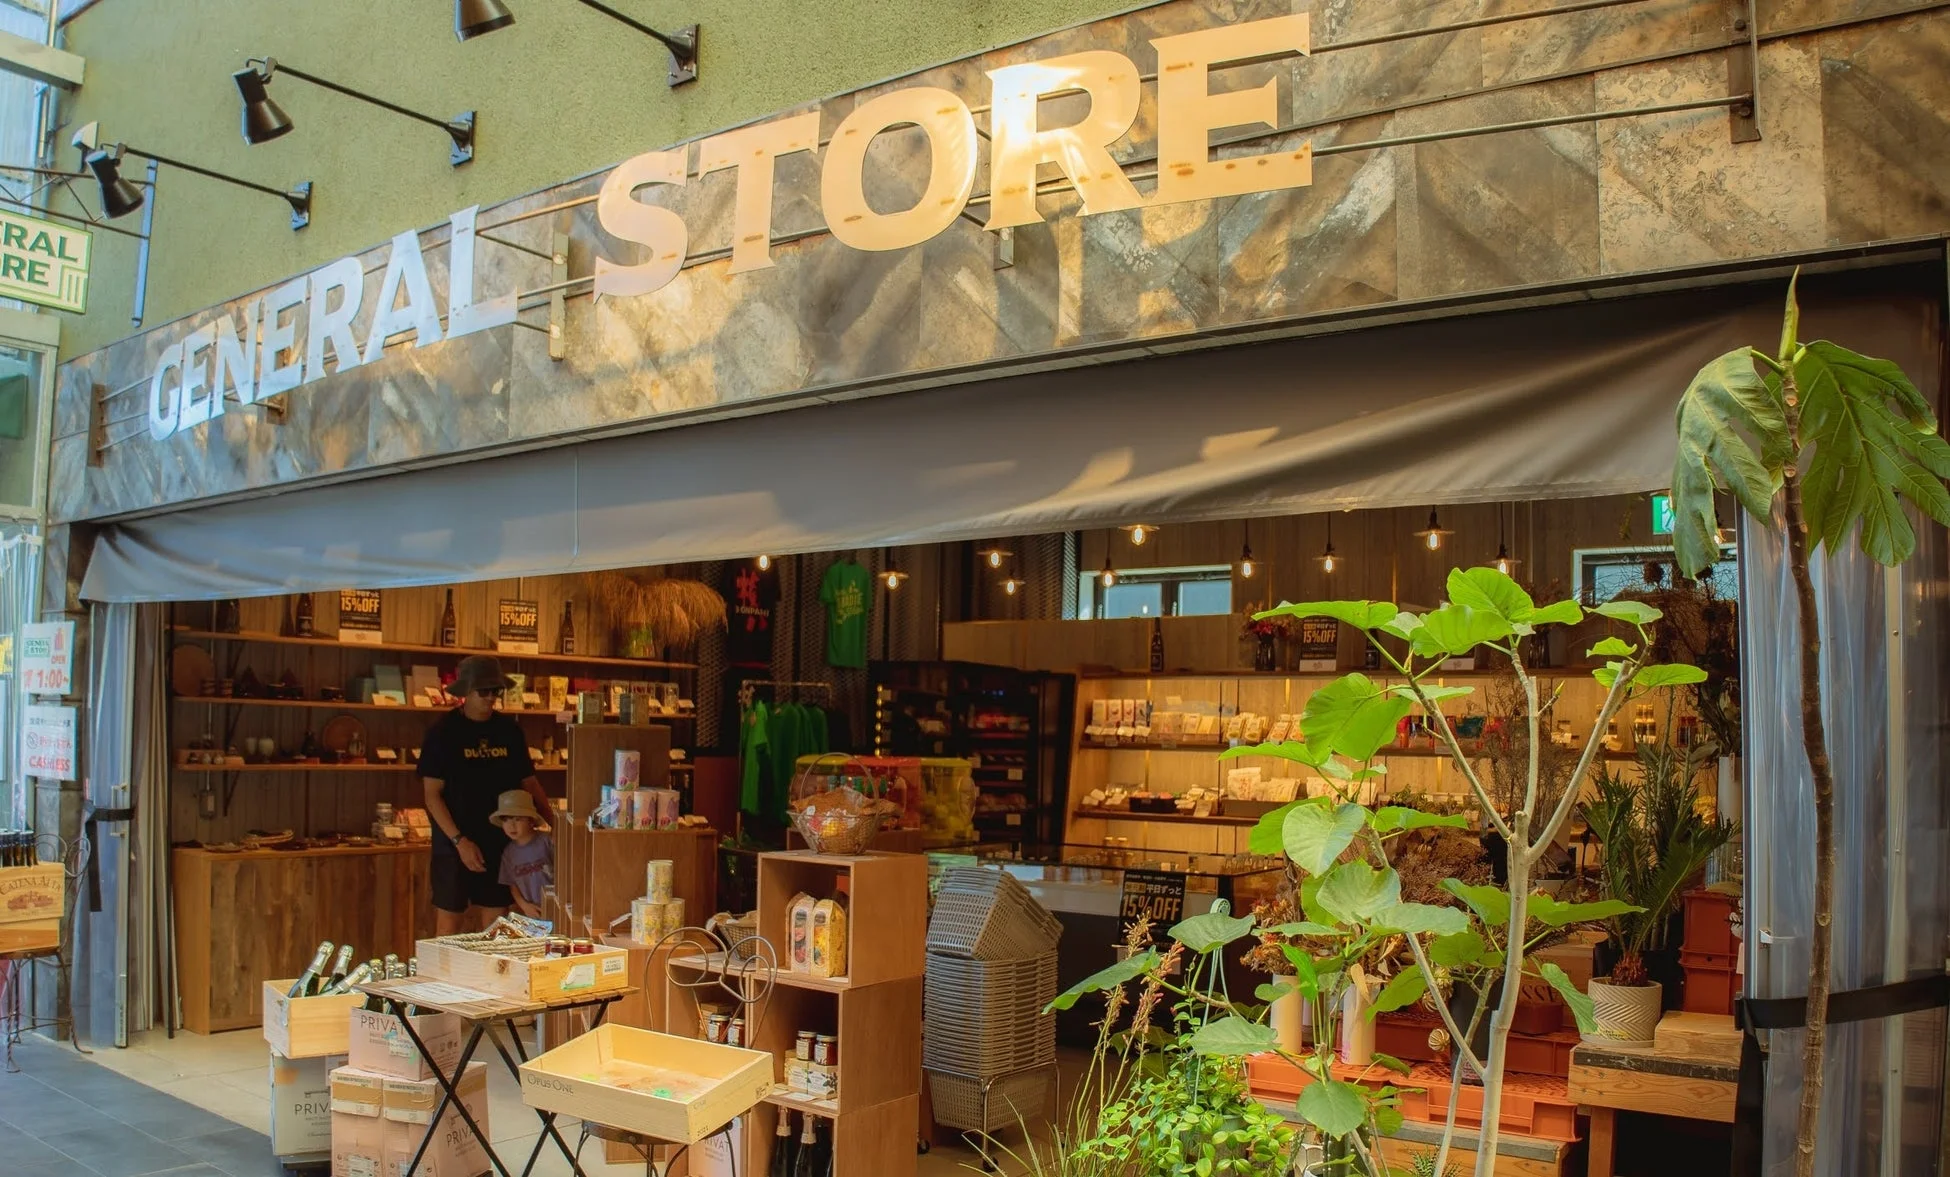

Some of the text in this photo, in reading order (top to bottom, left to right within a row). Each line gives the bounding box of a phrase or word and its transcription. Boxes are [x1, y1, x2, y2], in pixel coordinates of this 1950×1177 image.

[0, 221, 79, 263] RAL
[149, 12, 1312, 442] GENERAL STORE
[0, 252, 50, 287] RE
